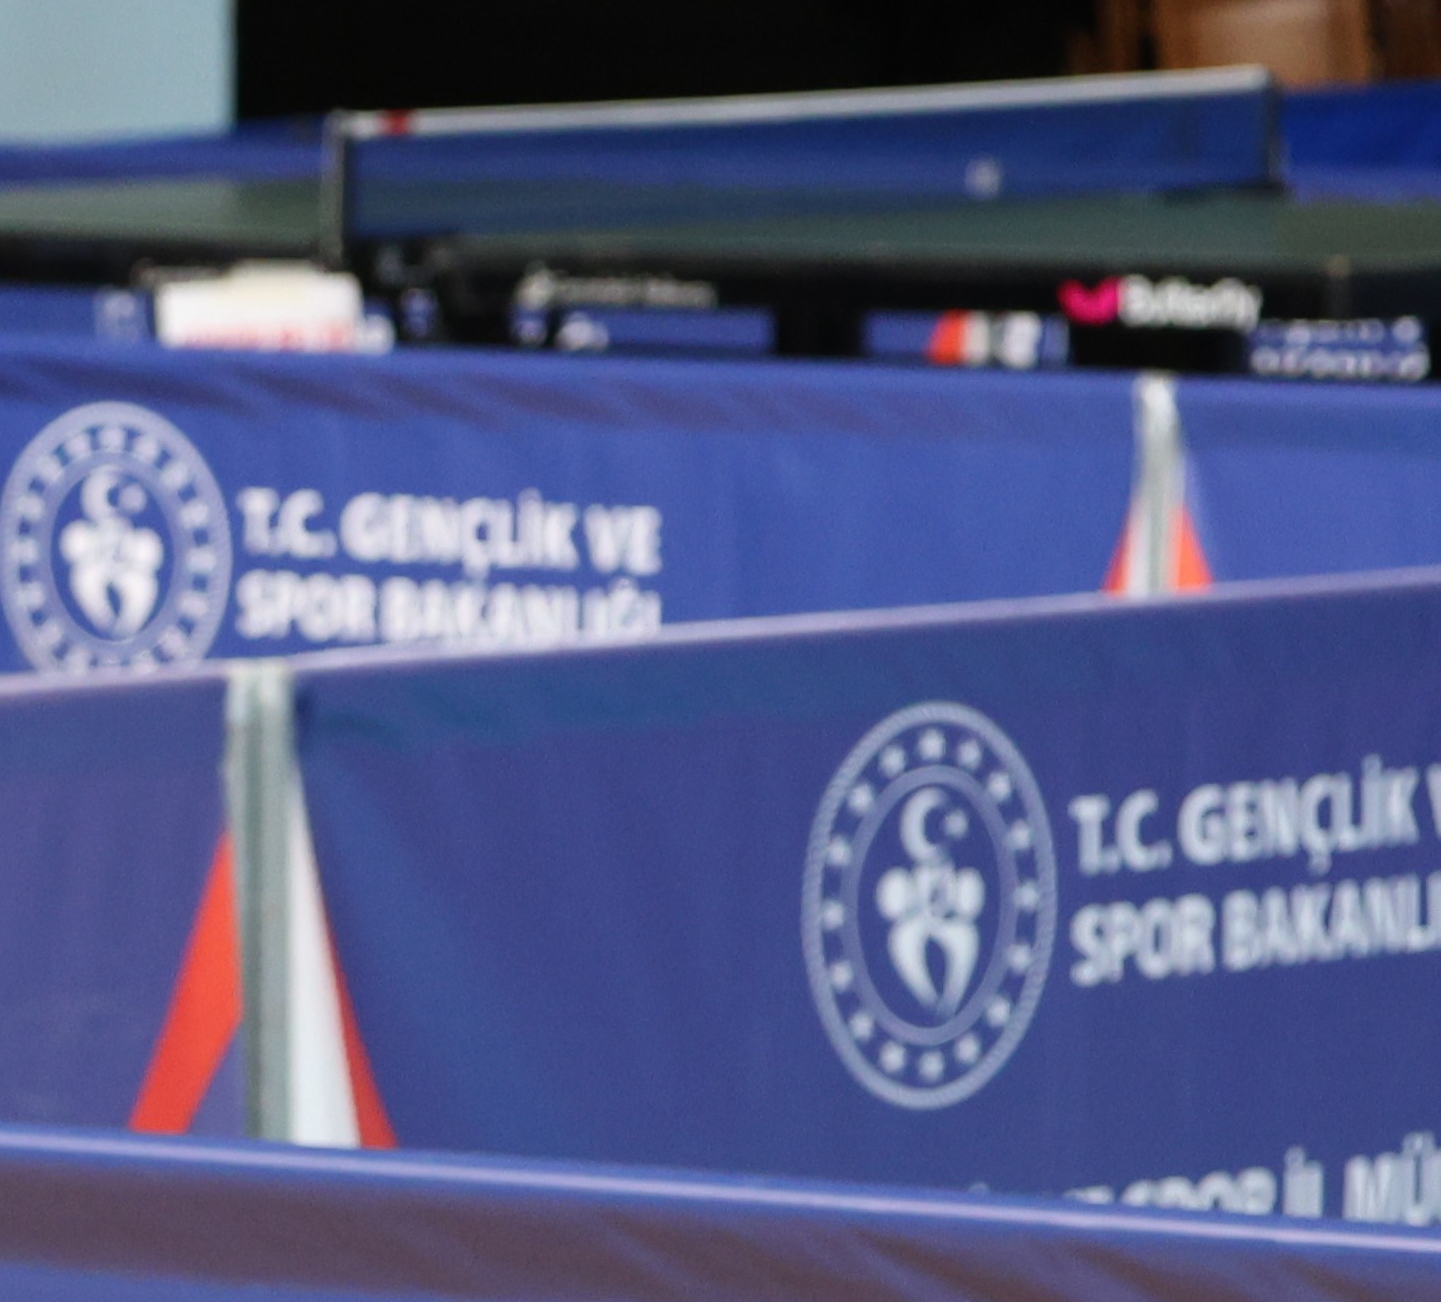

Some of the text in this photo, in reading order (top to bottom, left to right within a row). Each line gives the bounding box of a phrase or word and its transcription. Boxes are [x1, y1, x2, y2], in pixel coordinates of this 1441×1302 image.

[235, 487, 662, 580] T.C. GENÇLİK VE
[235, 568, 662, 645] SPOR BAKANLIĞI
[1067, 788, 1173, 876] T.C.
[1178, 753, 1420, 876] GENÇLİK
[1070, 893, 1216, 987] SPOR
